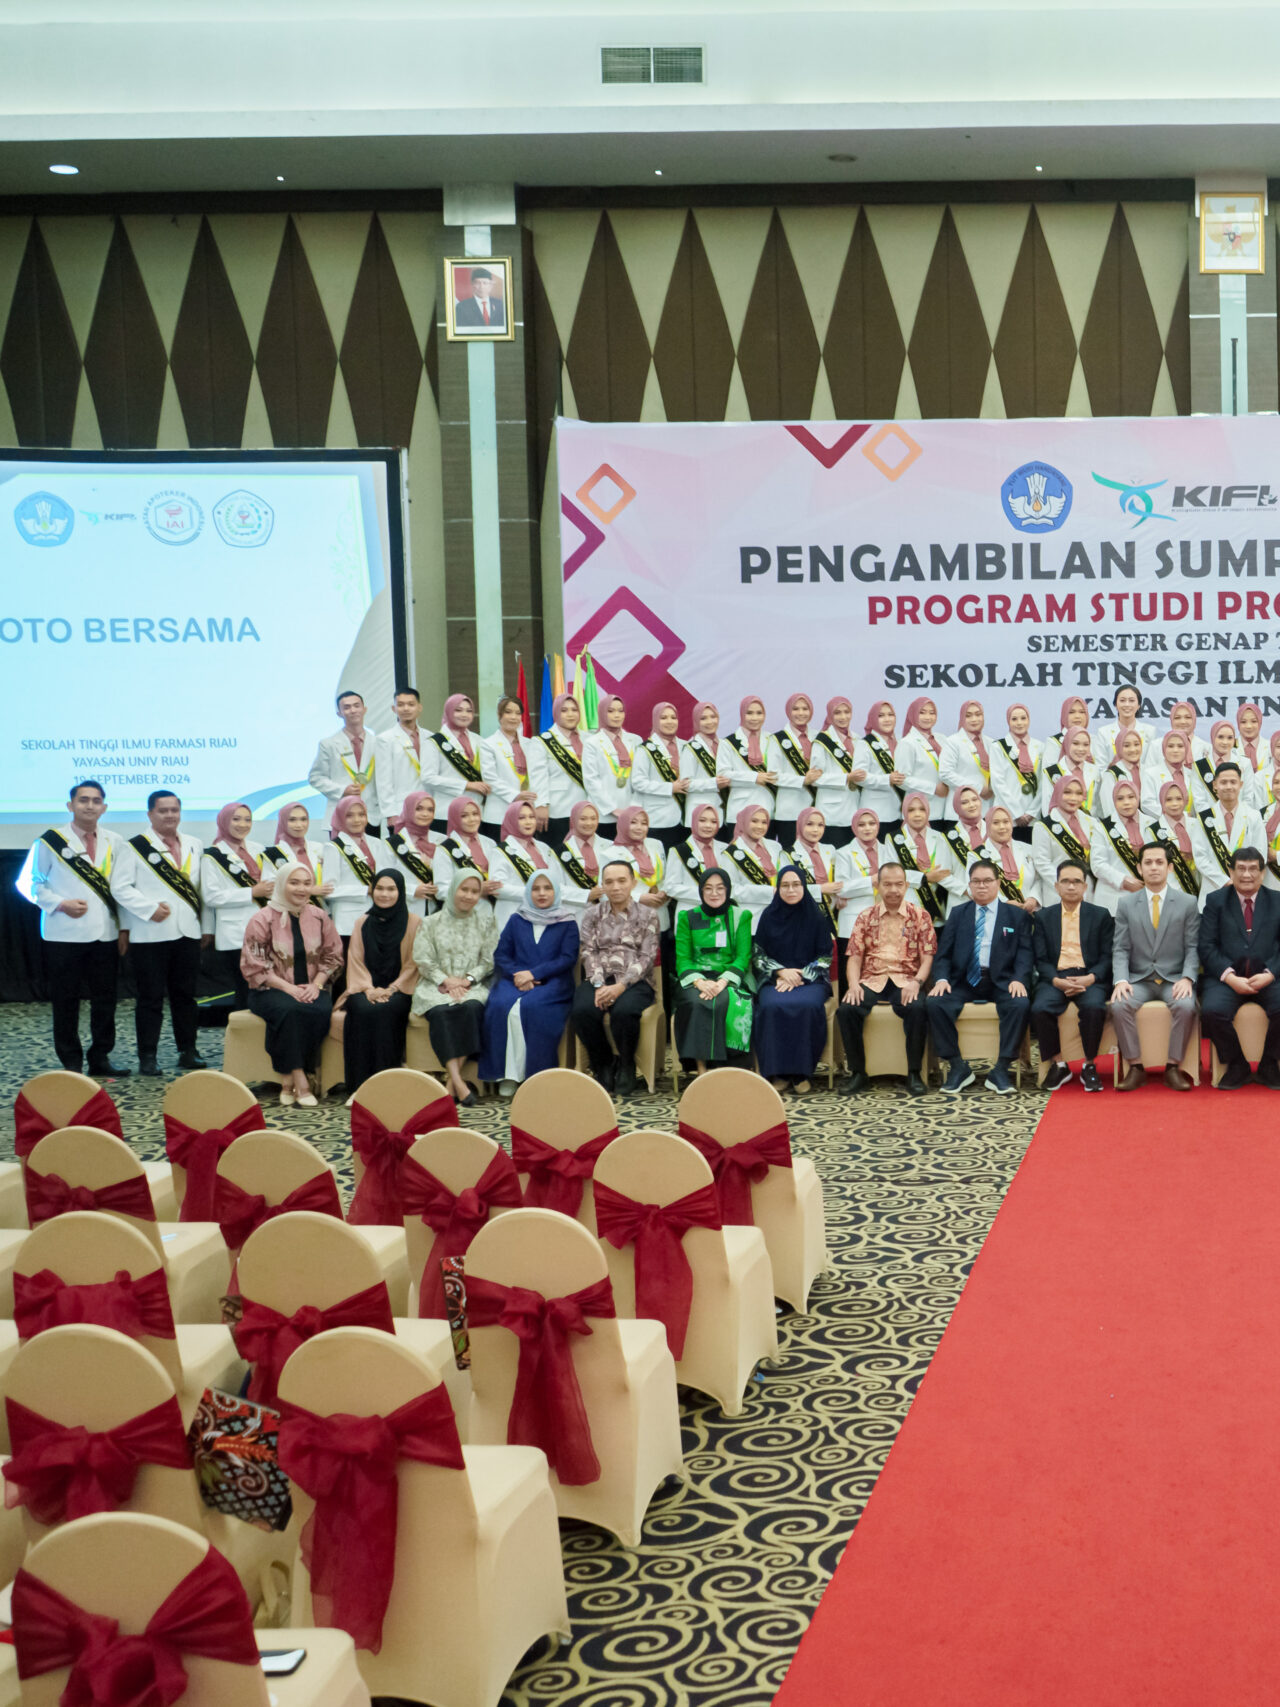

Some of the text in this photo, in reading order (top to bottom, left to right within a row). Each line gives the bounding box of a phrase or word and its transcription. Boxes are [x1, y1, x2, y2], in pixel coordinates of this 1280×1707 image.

[166, 520, 184, 529] IAI
[740, 542, 1135, 583] PENGAMBILAN
[868, 594, 1075, 624] PROGRAM
[1091, 592, 1202, 622] STUDI
[84, 617, 260, 643] BERSAMA
[1027, 634, 1168, 652] SEMESTER
[1176, 633, 1268, 651] GENAP
[885, 663, 1062, 688] SEKOLAH
[1072, 661, 1208, 687] TINGGI
[21, 738, 237, 752] SEKOLAH TINGGI ILMU FARMASI RIAU
[72, 756, 189, 767] YAYASAN UNIV RIAU
[90, 774, 159, 785] SEPTEMBER
[162, 774, 191, 785] 2024
